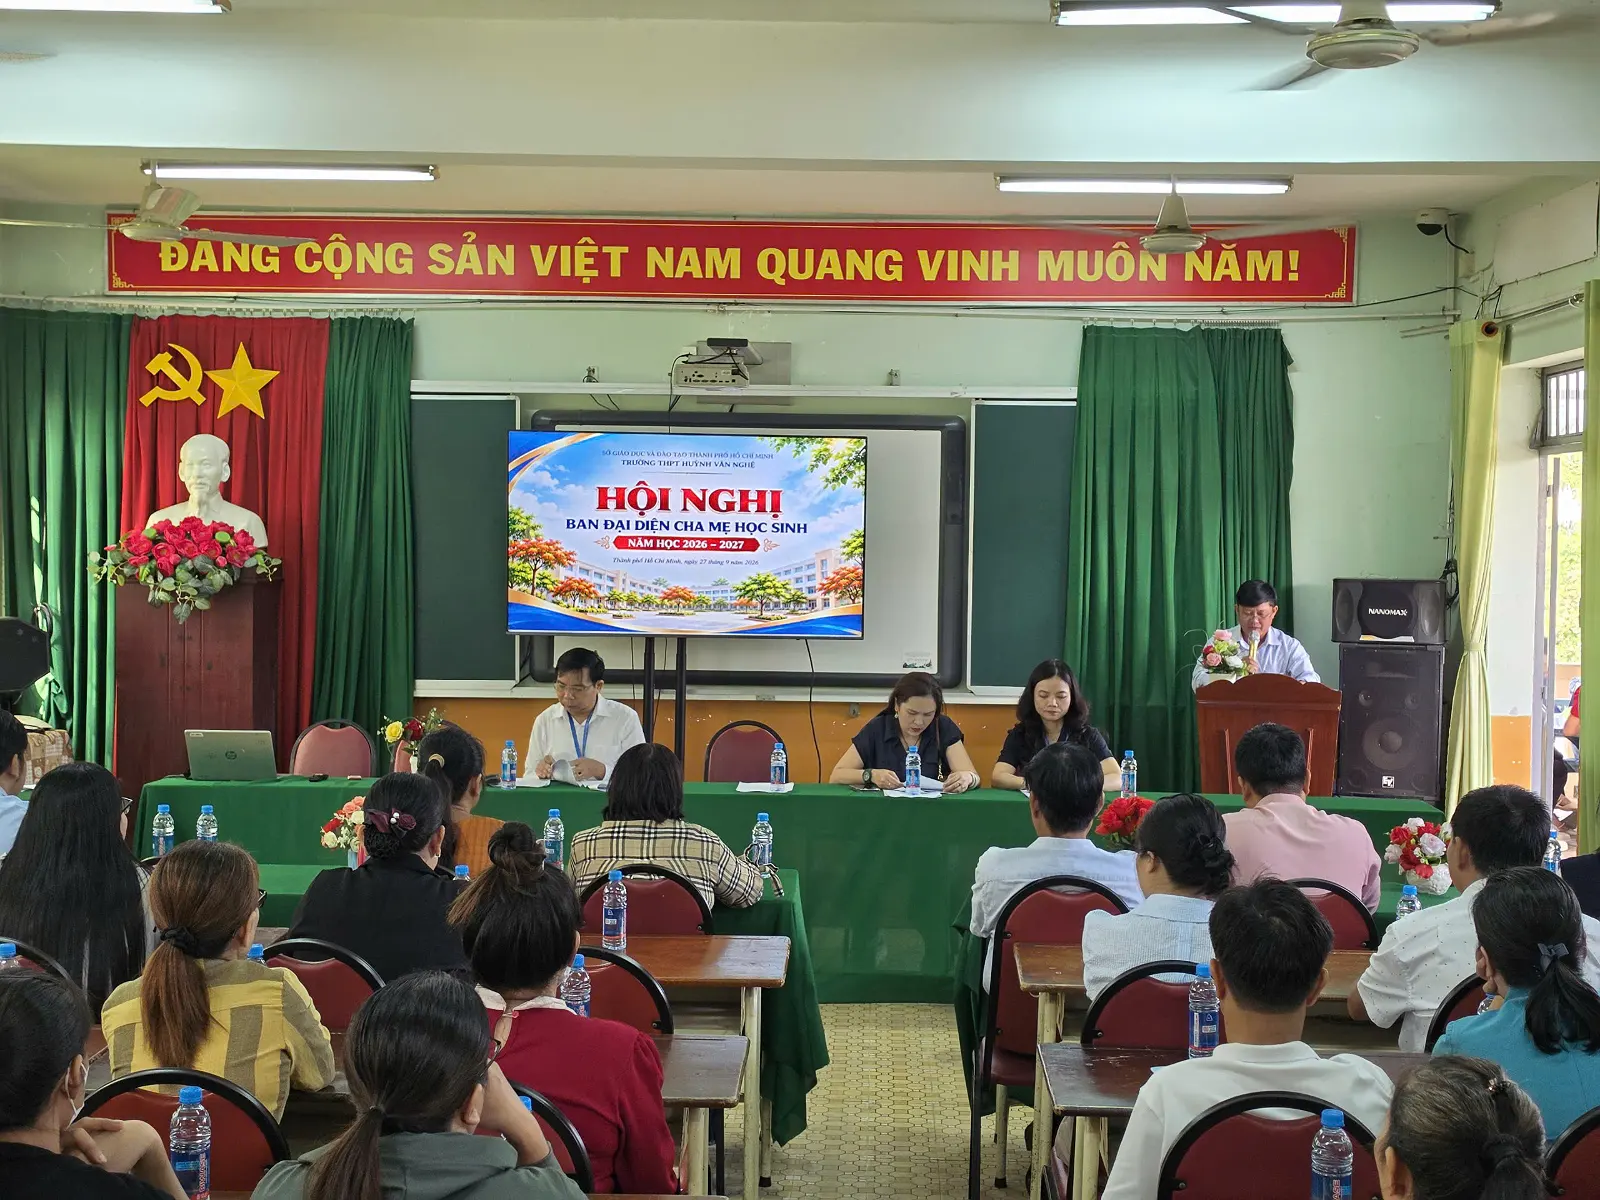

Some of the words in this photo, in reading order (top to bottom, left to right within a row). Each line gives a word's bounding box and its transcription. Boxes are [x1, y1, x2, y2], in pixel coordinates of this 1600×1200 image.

[294, 233, 414, 281] CỘNG
[428, 231, 515, 277] SẢN
[529, 237, 629, 284] VIỆT
[646, 246, 741, 280] NAM
[757, 247, 903, 286] QUANG
[918, 249, 1020, 283] VINH
[1038, 241, 1167, 283] MUÔN
[1185, 242, 1300, 283] NĂM!
[621, 458, 656, 466] TRƯỜNG
[658, 459, 681, 467] THPT
[682, 459, 712, 467] HUỲNH
[756, 452, 774, 460] MINH
[597, 481, 671, 517] HỘI
[682, 489, 783, 519] NGHỊ
[566, 518, 599, 531] BAN
[603, 519, 631, 533] ĐẠI
[635, 517, 670, 534] DIỆN
[673, 520, 705, 532] CHA
[708, 521, 731, 535] MẸ
[735, 522, 768, 536] HỌC
[771, 522, 808, 534] SINH
[628, 538, 654, 548] NĂM
[655, 539, 681, 550] HỌC
[682, 539, 708, 549] 2026
[719, 540, 744, 550] 2027
[1332, 1179, 1341, 1200] ASE
